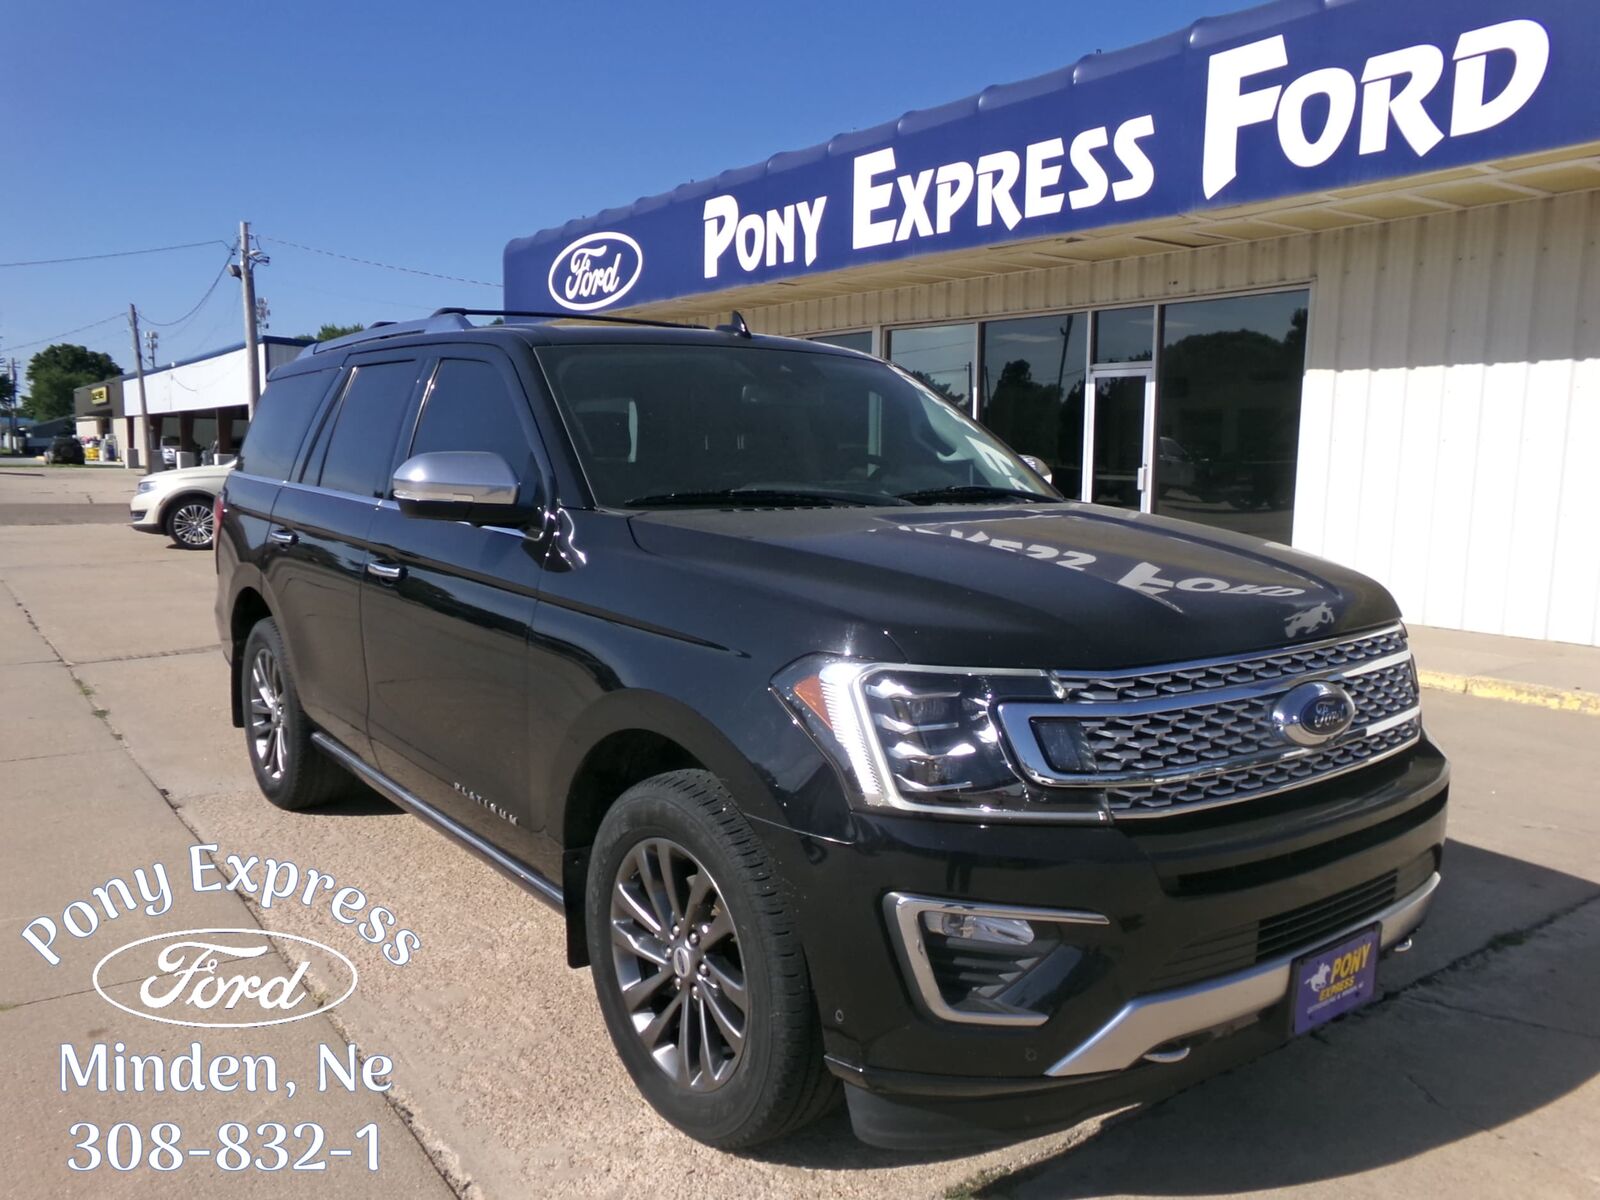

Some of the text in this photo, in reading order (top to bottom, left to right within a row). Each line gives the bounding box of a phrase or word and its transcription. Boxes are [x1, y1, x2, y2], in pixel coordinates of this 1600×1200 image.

[703, 19, 1550, 279] PONY EXPRESS FORD
[565, 244, 622, 300] Ford
[453, 781, 518, 826] PLATINUM
[1329, 941, 1372, 984] PONY
[1318, 976, 1355, 1002] EXPRESS
